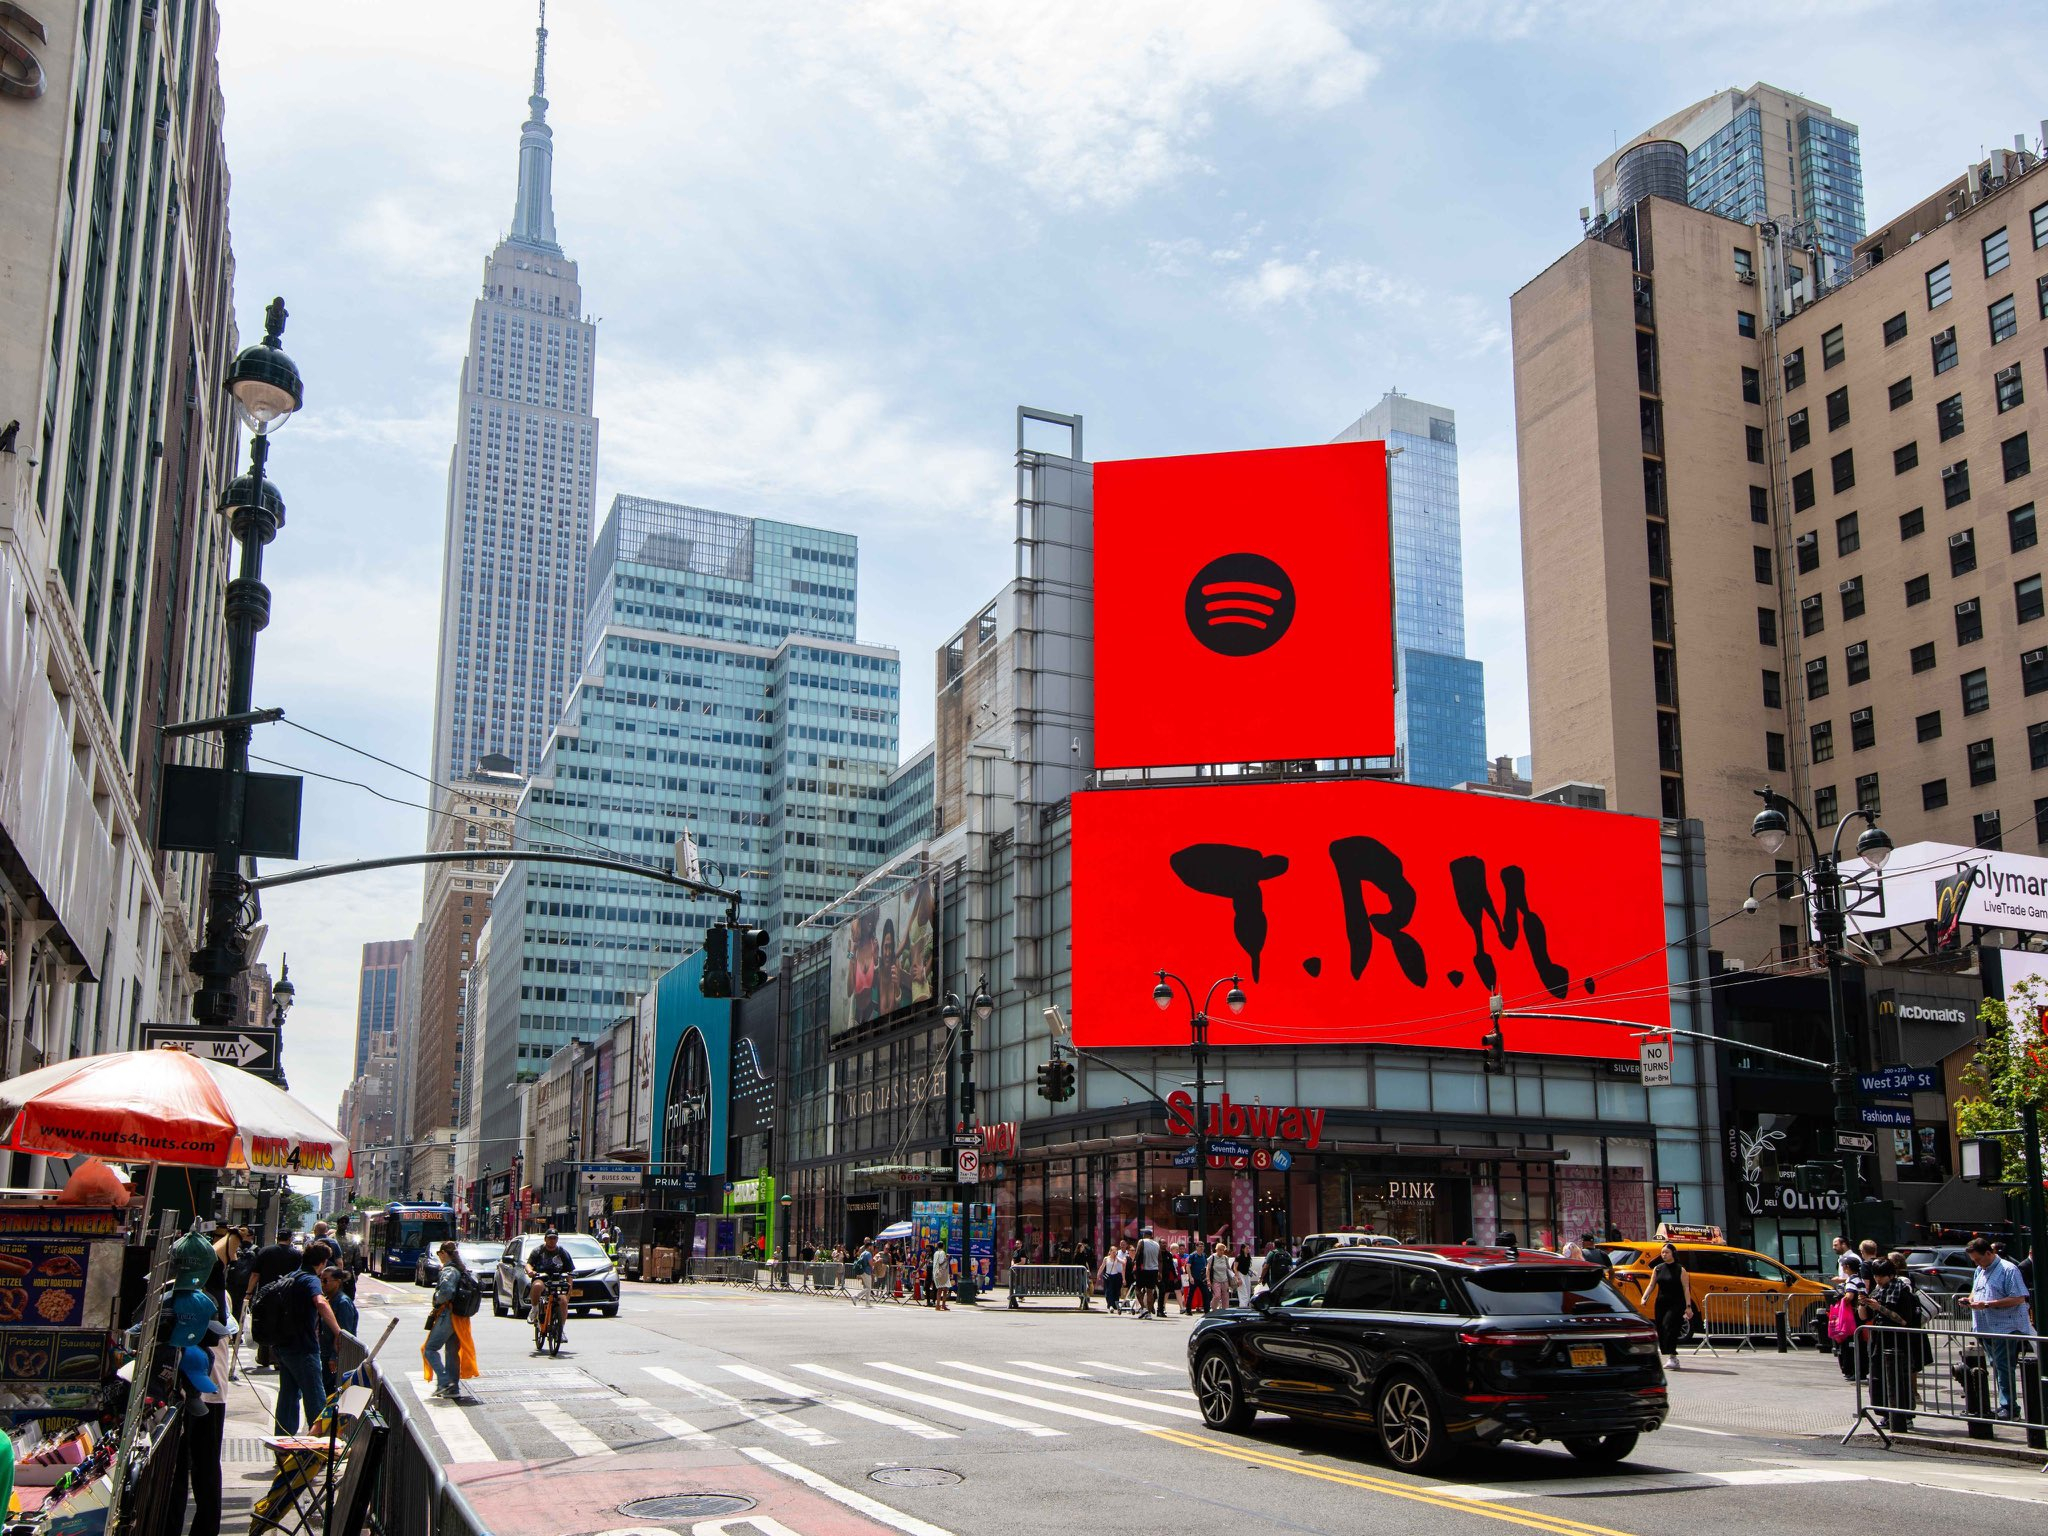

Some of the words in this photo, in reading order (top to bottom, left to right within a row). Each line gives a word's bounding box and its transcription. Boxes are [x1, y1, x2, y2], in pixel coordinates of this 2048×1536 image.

[1984, 901, 2026, 916] LiveTrade
[1169, 835, 1595, 999] T.R.M.
[1899, 1004, 1965, 1023] McDonald's
[212, 1042, 250, 1057] WAY
[1647, 1048, 1662, 1058] NO
[1613, 1063, 1640, 1073] SILVER
[1643, 1062, 1669, 1072] TURNS
[1862, 1077, 1891, 1089] West
[1894, 1074, 1915, 1088] 34th
[1918, 1074, 1931, 1086] St
[1166, 1090, 1325, 1149] Subway
[1862, 1110, 1893, 1123] Fashion
[1895, 1112, 1911, 1124] Ave
[40, 1124, 216, 1153] www.nuts4nuts.com
[1842, 1137, 1853, 1145] ONE
[1857, 1138, 1869, 1146] WAY
[1211, 1144, 1236, 1154] Seventh
[1237, 1147, 1249, 1155] Ave
[1257, 1152, 1267, 1167] 3
[1273, 1150, 1288, 1168] MTA
[655, 1178, 681, 1186] PRIM
[1389, 1181, 1435, 1199] PINK
[1764, 1199, 1778, 1207] DELI
[1782, 1188, 1840, 1210] OLIYO
[421, 1212, 443, 1220] SERVICE
[1563, 1207, 1605, 1228] LOV
[58, 1245, 85, 1255] SAUSAGE
[0, 1278, 23, 1287] ETZEL
[33, 1279, 51, 1288] HONEY
[51, 1279, 72, 1288] ROASTED
[72, 1279, 83, 1288] NUT
[9, 1336, 50, 1348] Pretzel
[61, 1338, 102, 1349] Sausage
